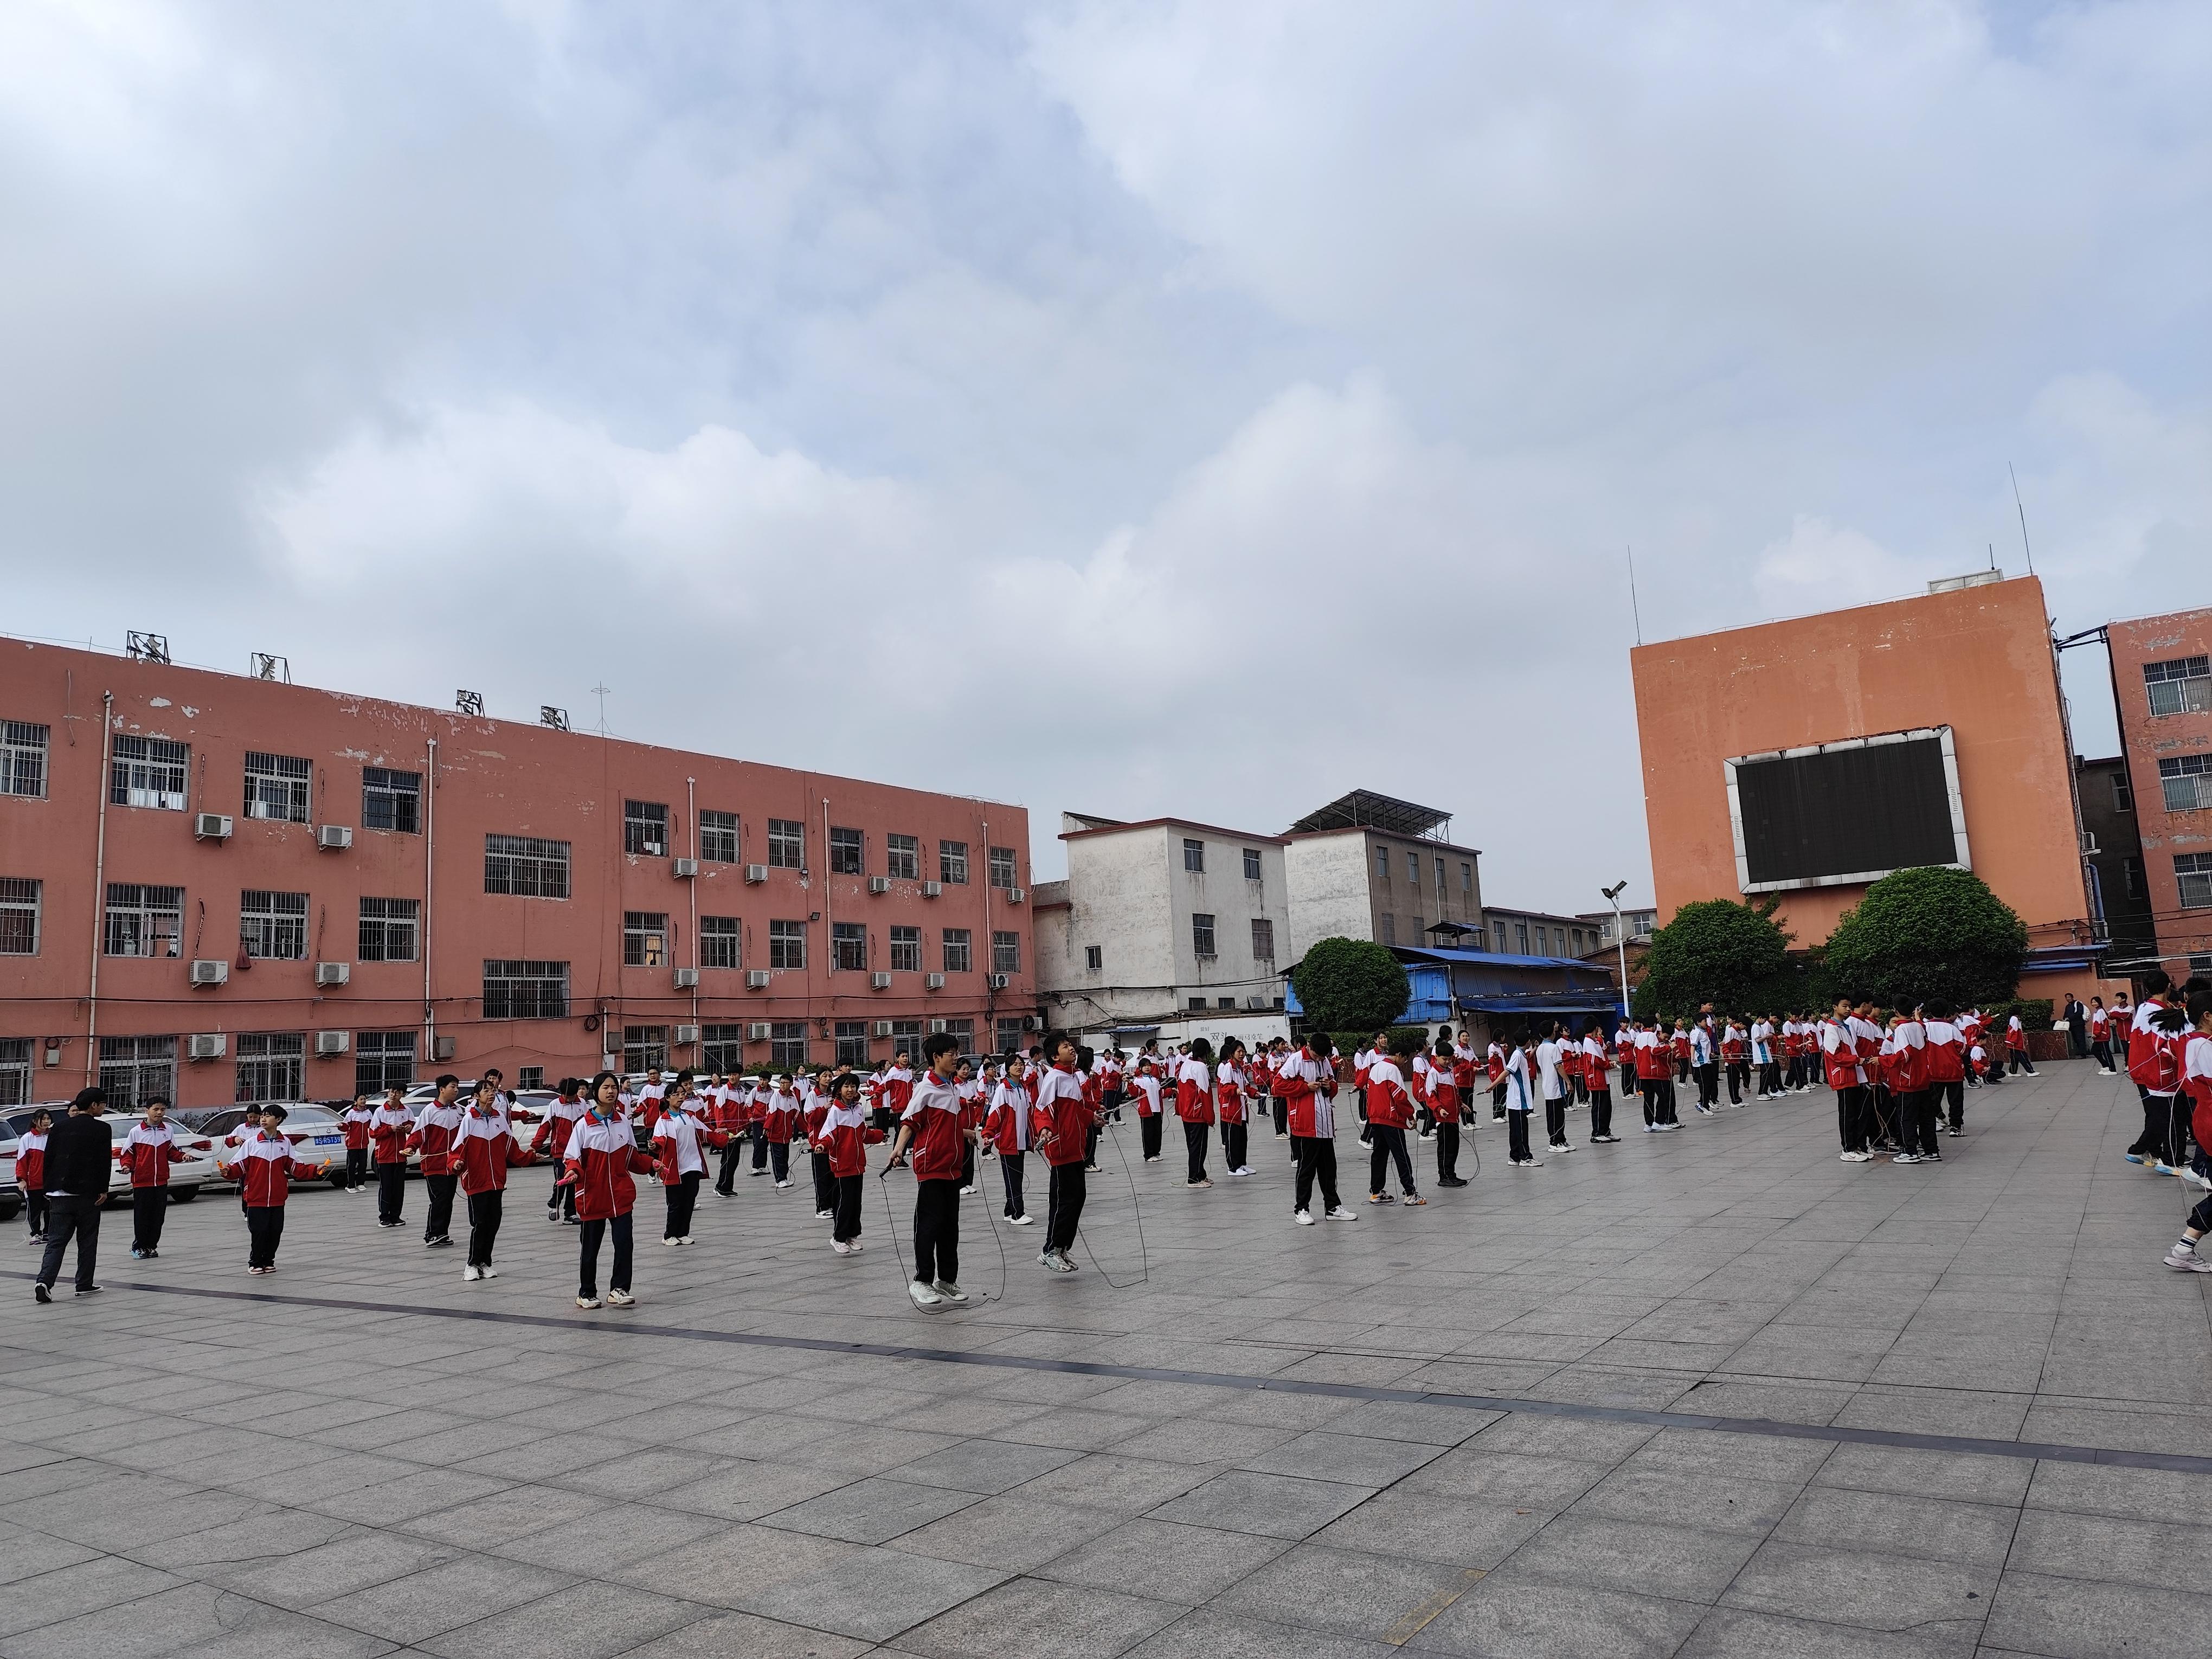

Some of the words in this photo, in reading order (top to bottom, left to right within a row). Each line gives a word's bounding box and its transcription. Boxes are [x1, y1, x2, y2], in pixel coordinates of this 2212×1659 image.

[1210, 1032, 1264, 1041] 双头画马克笔
